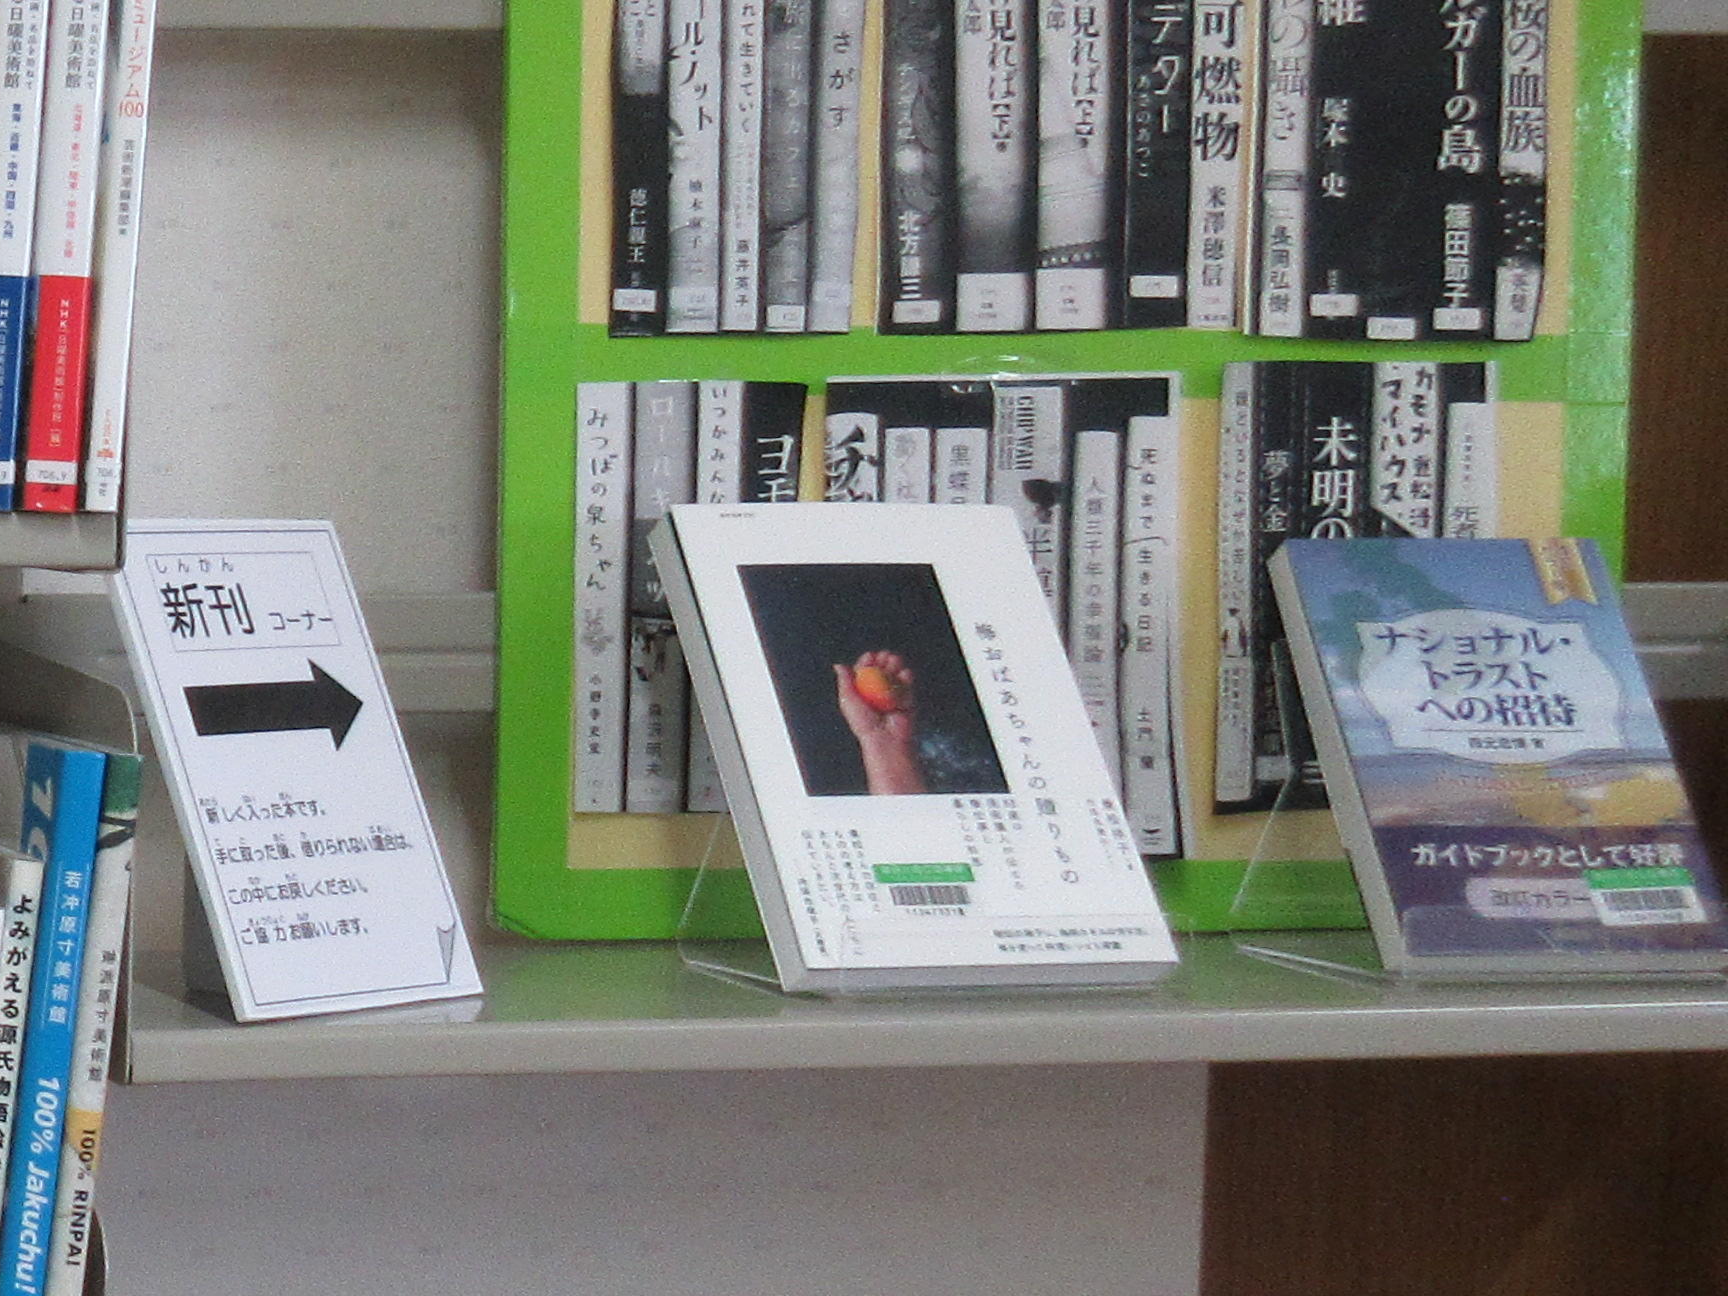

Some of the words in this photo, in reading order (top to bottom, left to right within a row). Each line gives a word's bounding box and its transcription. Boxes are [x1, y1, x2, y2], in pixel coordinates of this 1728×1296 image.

[1194, 0, 1241, 161] 可燃物
[900, 210, 923, 299] 北方謙三
[1202, 186, 1225, 286] 米澤穂信
[586, 407, 618, 591] みつばの泉ちゃん
[1262, 451, 1289, 532] 夢と金
[160, 583, 255, 638] 新刊
[268, 612, 333, 631] コーナー
[1376, 625, 1572, 654] ナショナル・
[1418, 695, 1577, 728] への招待
[1424, 662, 1550, 690] トラスト
[48, 870, 83, 1024] 若冲原寸美術館
[30, 1078, 60, 1152] 100%
[78, 1128, 96, 1180] 100%
[15, 1159, 50, 1294] Jakuchu!
[66, 1189, 89, 1267] RINPAI
